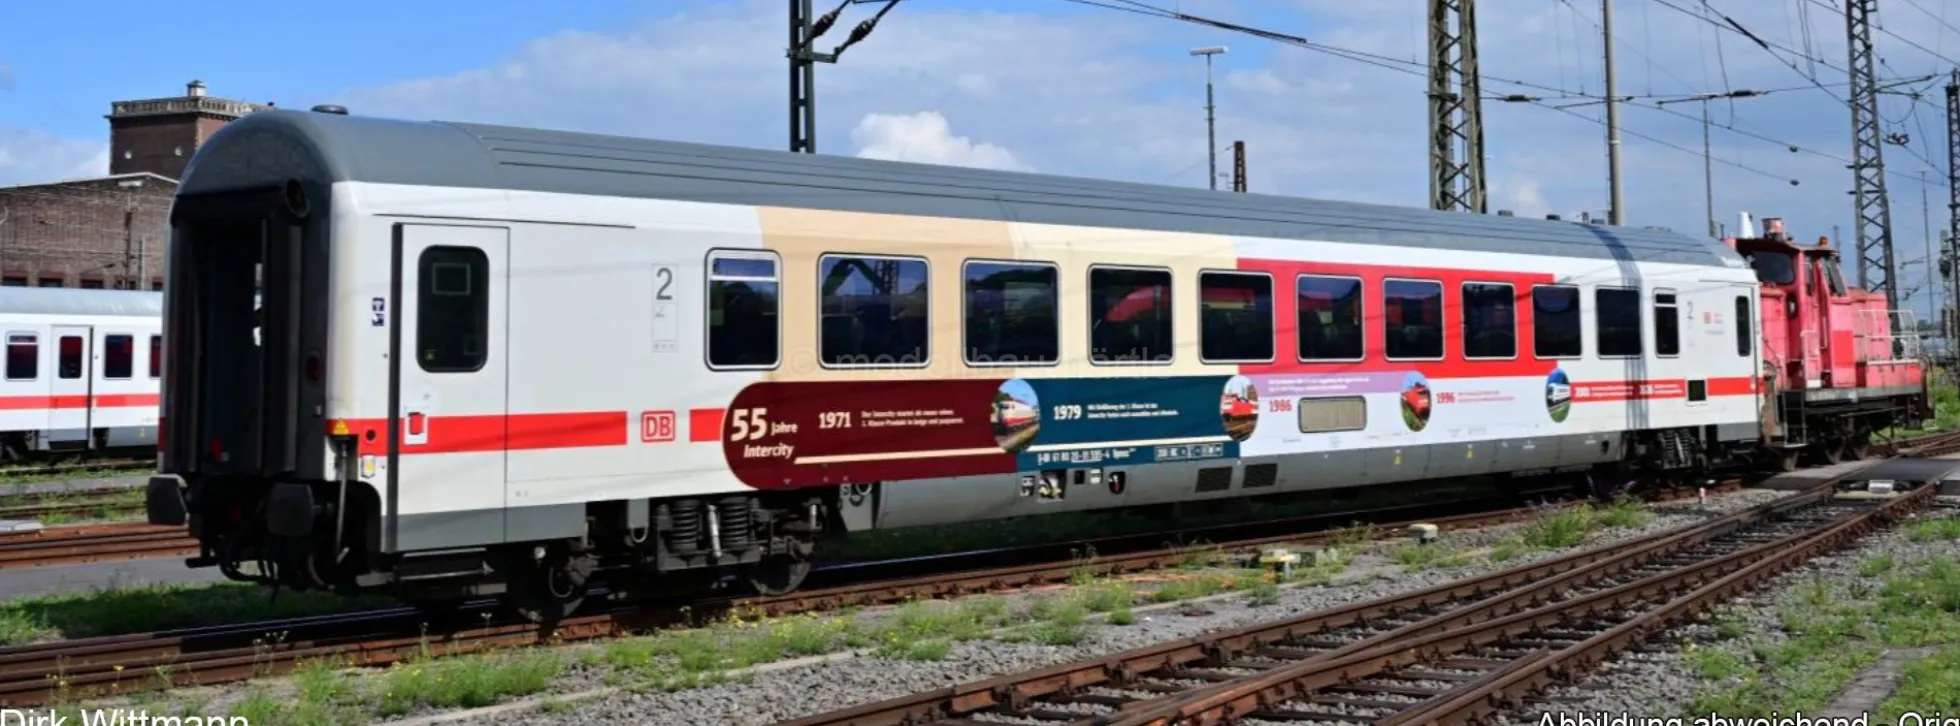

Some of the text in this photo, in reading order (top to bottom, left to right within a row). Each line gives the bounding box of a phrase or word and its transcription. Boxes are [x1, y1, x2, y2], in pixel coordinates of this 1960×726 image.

[656, 267, 673, 301] 2
[1268, 399, 1293, 413] 1986
[1435, 391, 1456, 405] 1996
[818, 411, 852, 429] 1971
[1053, 404, 1082, 420] 1979
[645, 414, 672, 439] DB
[730, 407, 799, 442] 55 Jahre
[743, 442, 795, 459] Intercity
